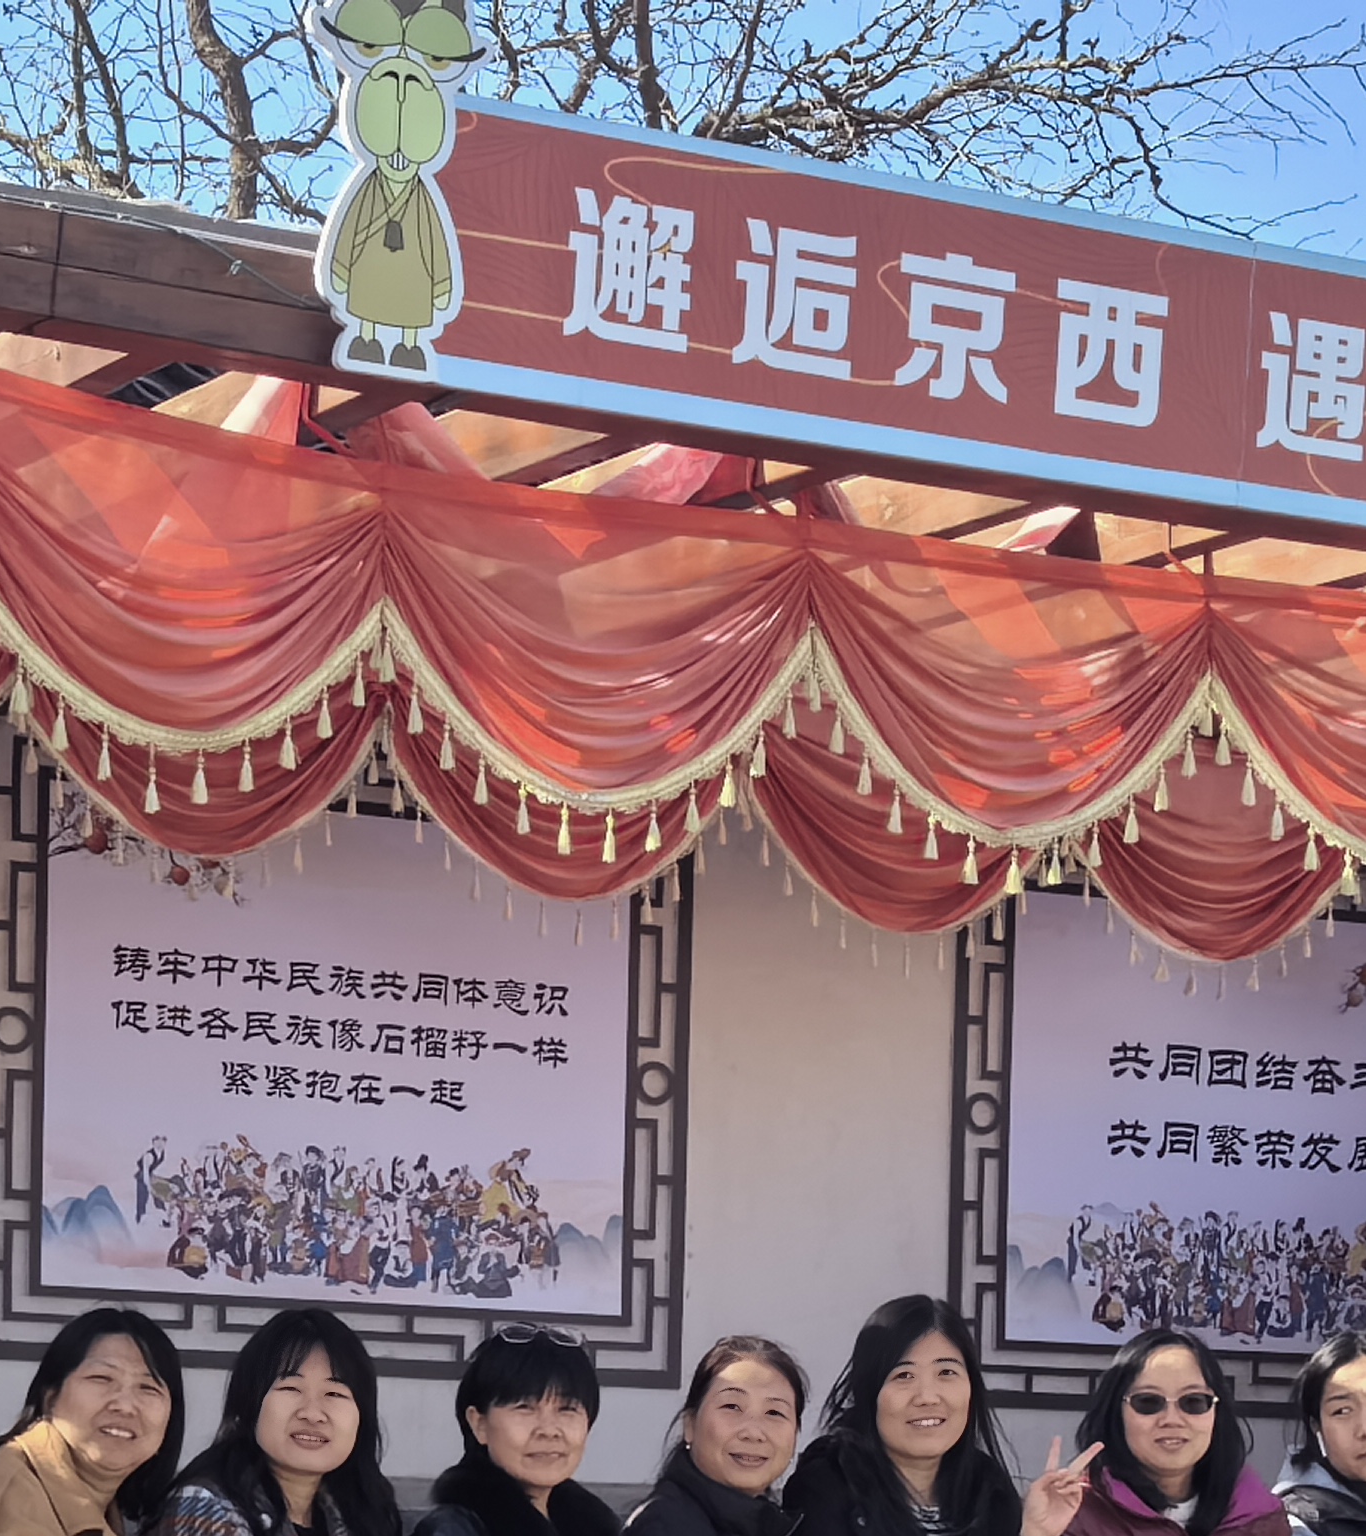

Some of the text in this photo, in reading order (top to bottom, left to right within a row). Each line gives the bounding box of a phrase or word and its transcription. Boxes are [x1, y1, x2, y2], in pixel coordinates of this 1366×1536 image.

[564, 188, 1169, 428] 邂逅京西
[113, 945, 569, 1017] 铸牢中华民族共同体意识
[111, 1000, 569, 1068] 促进各民族像石榴籽一样
[221, 1062, 467, 1112] 紧紧抱在一起
